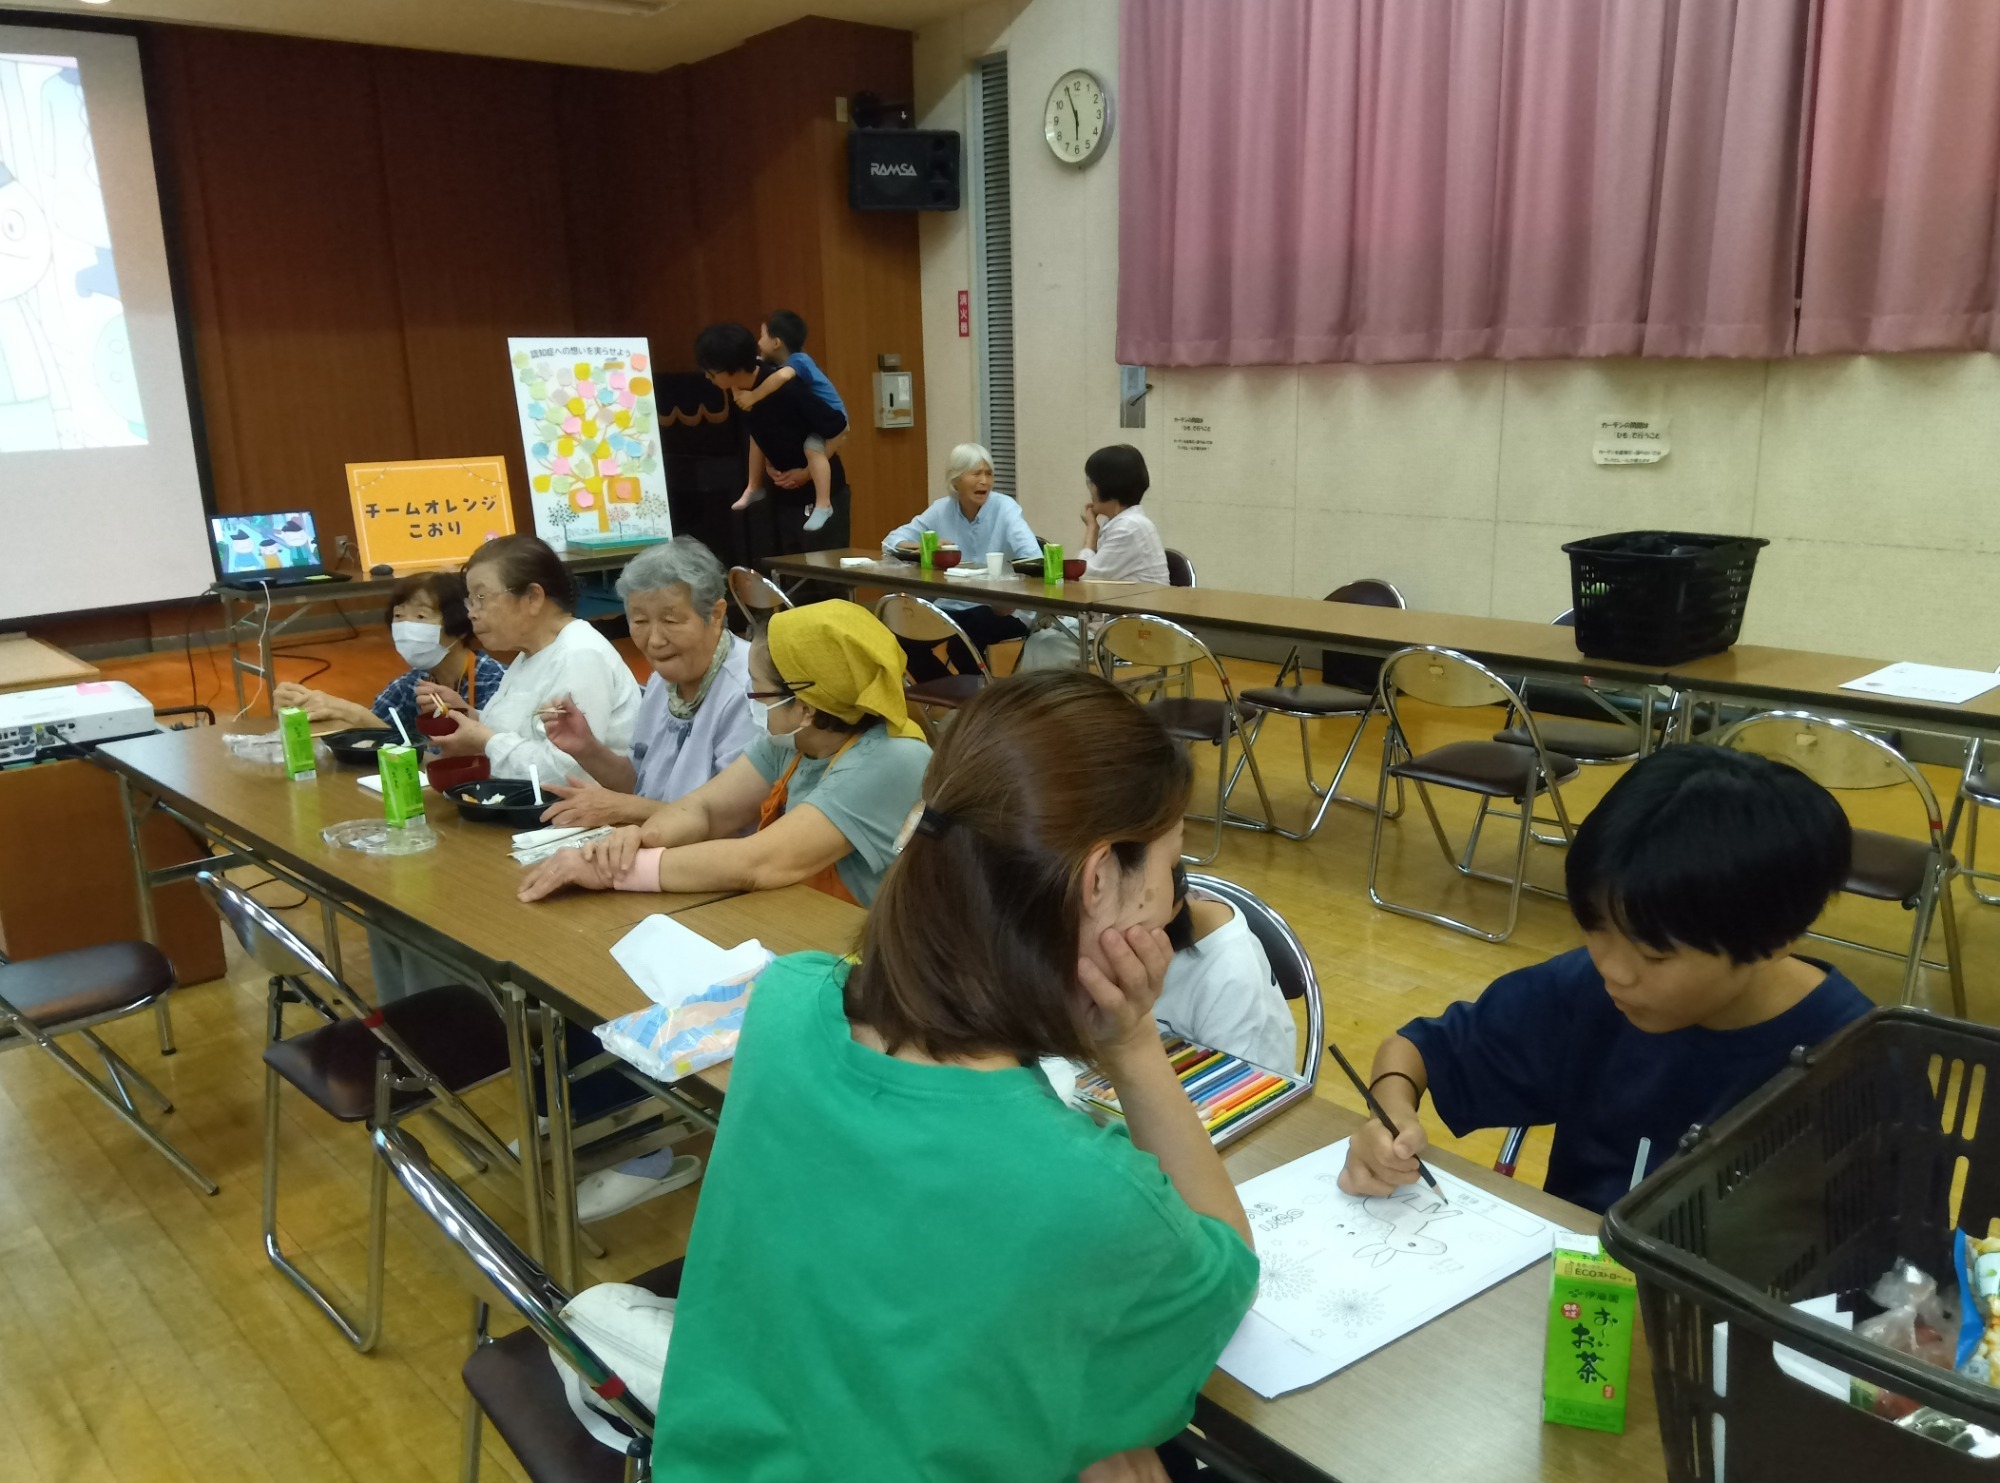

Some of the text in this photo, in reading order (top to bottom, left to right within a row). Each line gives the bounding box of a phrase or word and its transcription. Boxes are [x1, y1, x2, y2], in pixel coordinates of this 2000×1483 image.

[1074, 81, 1081, 91] 12
[1086, 83, 1090, 91] 1
[1093, 94, 1099, 104] 2
[1056, 100, 1064, 110] 10
[1096, 109, 1102, 120] 3
[1054, 116, 1059, 126] 9
[1057, 131, 1062, 141] 8
[1093, 127, 1098, 136] 4
[1065, 142, 1070, 152] 7
[1085, 139, 1090, 149] 5
[1074, 145, 1079, 154] 6
[870, 162, 918, 176] RAMSA
[530, 346, 631, 359] 認知症への想いを実らせよう
[365, 495, 497, 518] チームオレンジ
[409, 521, 461, 539] こおり
